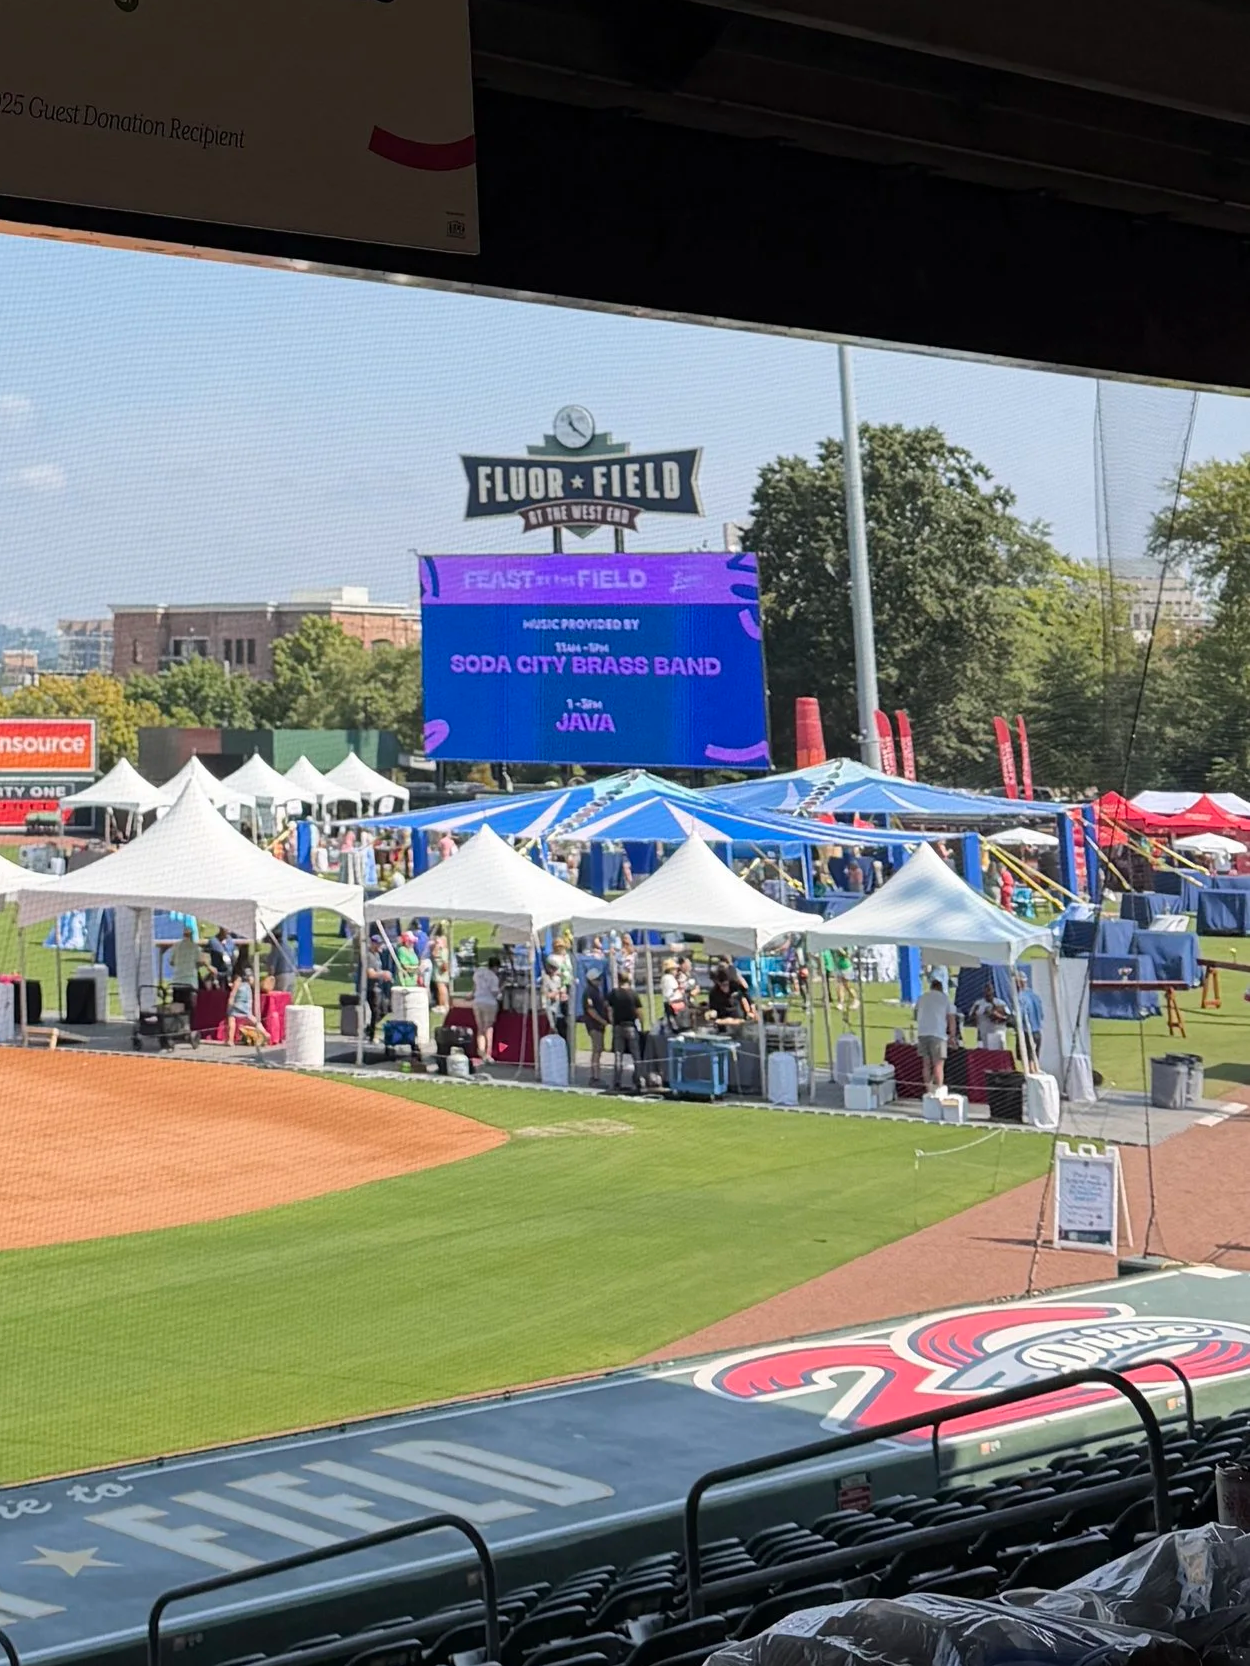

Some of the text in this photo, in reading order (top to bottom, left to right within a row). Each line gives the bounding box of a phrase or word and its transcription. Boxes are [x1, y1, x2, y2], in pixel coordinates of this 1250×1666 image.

[28, 96, 80, 124] Guest
[83, 104, 166, 138] Donation
[169, 117, 245, 149] Recipient
[477, 460, 682, 504] FLUOR FIELD
[528, 504, 631, 525] AT THE WEST END
[463, 569, 535, 589] FEAST
[577, 568, 648, 590] FIELD
[522, 618, 640, 631] MUSIC PROVIDED BY
[450, 654, 722, 676] SODA CITY BRASS BAND
[555, 713, 616, 732] JAVA
[29, 785, 67, 798] ONE
[1021, 1325, 1213, 1375] Drive
[66, 1477, 134, 1504] to
[83, 1439, 616, 1572] FIELD
